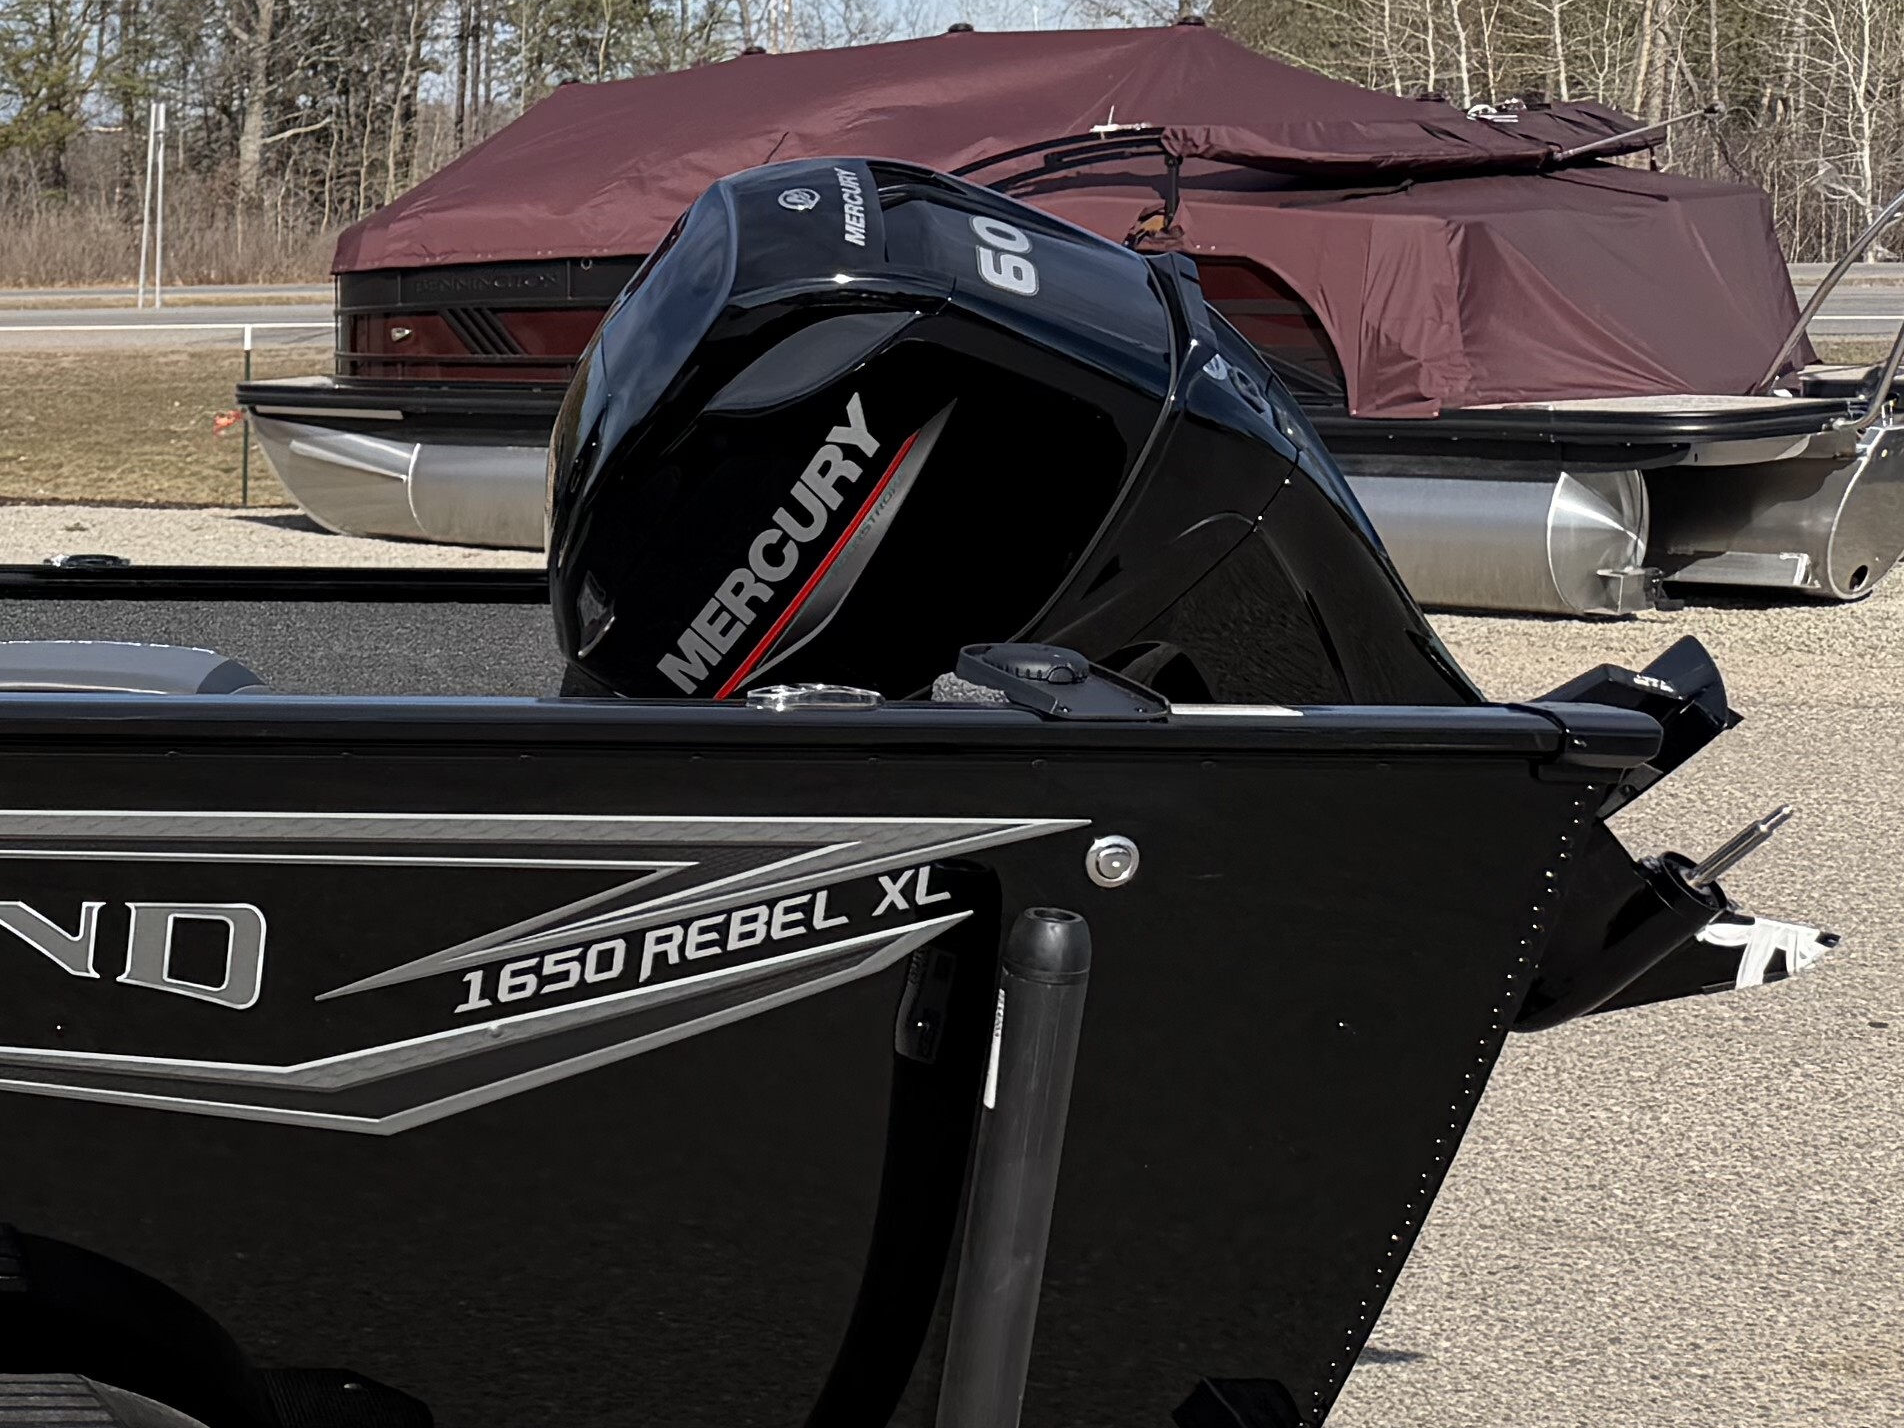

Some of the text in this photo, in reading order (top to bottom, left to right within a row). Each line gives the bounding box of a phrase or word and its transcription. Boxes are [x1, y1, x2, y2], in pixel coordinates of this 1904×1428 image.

[833, 166, 867, 247] MERCURY
[968, 215, 1040, 297] 60
[655, 391, 881, 695] MERCURY
[453, 864, 952, 1014] 1650 REBEL XL
